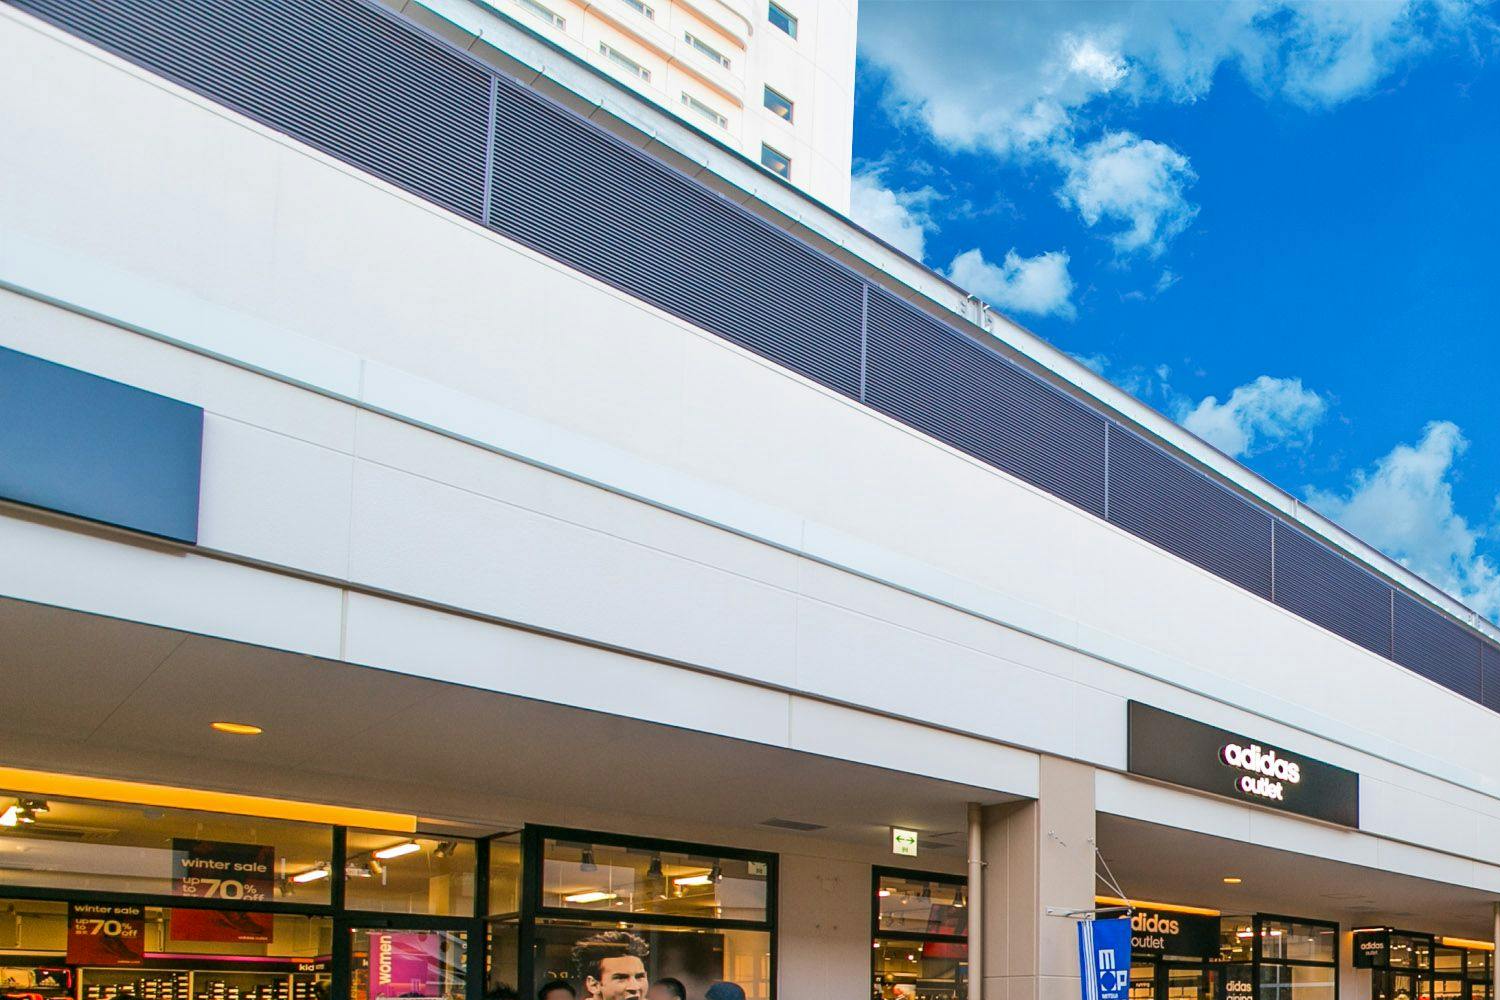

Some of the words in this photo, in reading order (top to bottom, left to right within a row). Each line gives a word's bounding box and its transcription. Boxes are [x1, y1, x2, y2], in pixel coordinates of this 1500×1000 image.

[1224, 743, 1301, 784] adidas
[1241, 775, 1283, 801] outlet
[181, 858, 230, 870] winter
[234, 862, 267, 873] sale
[74, 905, 112, 914] winter
[114, 907, 140, 915] sale
[1119, 912, 1180, 935] didas
[1130, 935, 1165, 950] outlet
[379, 935, 392, 985] women
